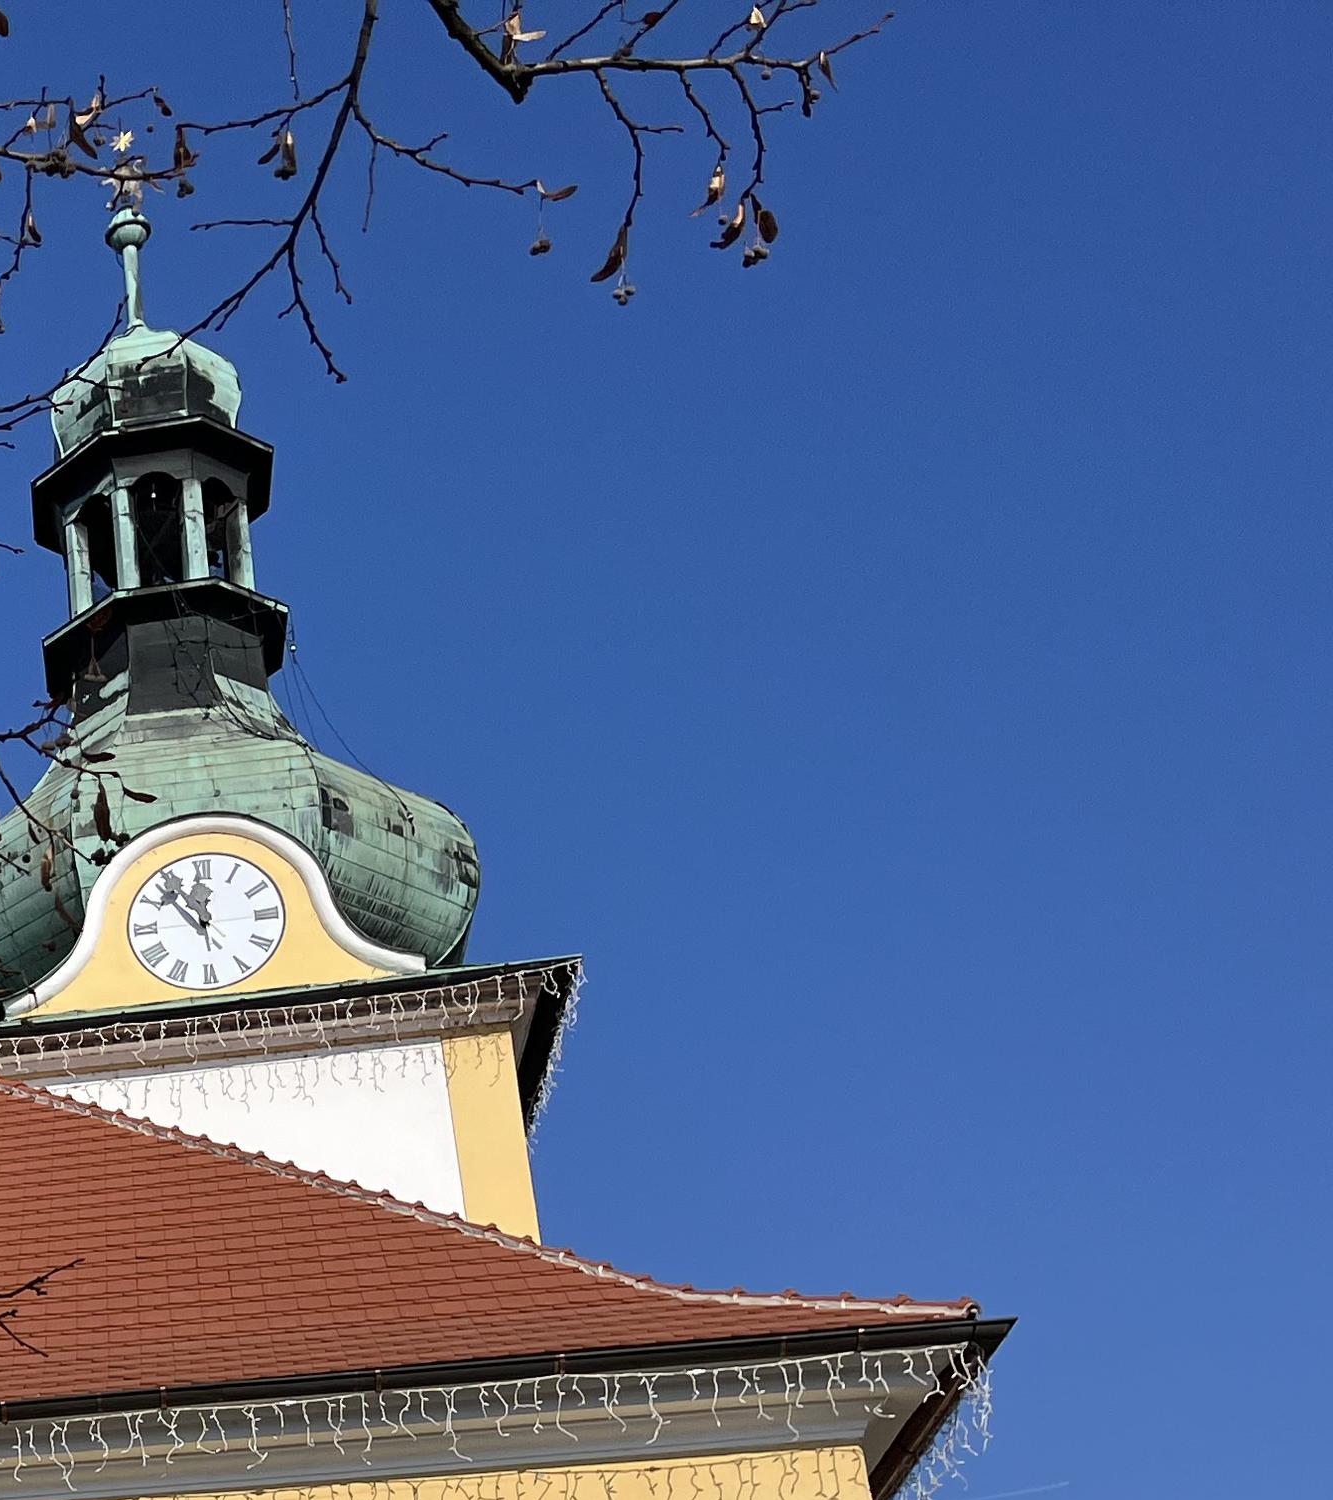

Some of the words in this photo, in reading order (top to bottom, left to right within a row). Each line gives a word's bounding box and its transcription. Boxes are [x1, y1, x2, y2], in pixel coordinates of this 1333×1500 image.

[225, 863, 241, 884] I
[245, 880, 268, 899] II
[254, 906, 279, 921] III
[134, 921, 158, 937] IX
[202, 963, 219, 984] VI
[233, 955, 251, 974] V
